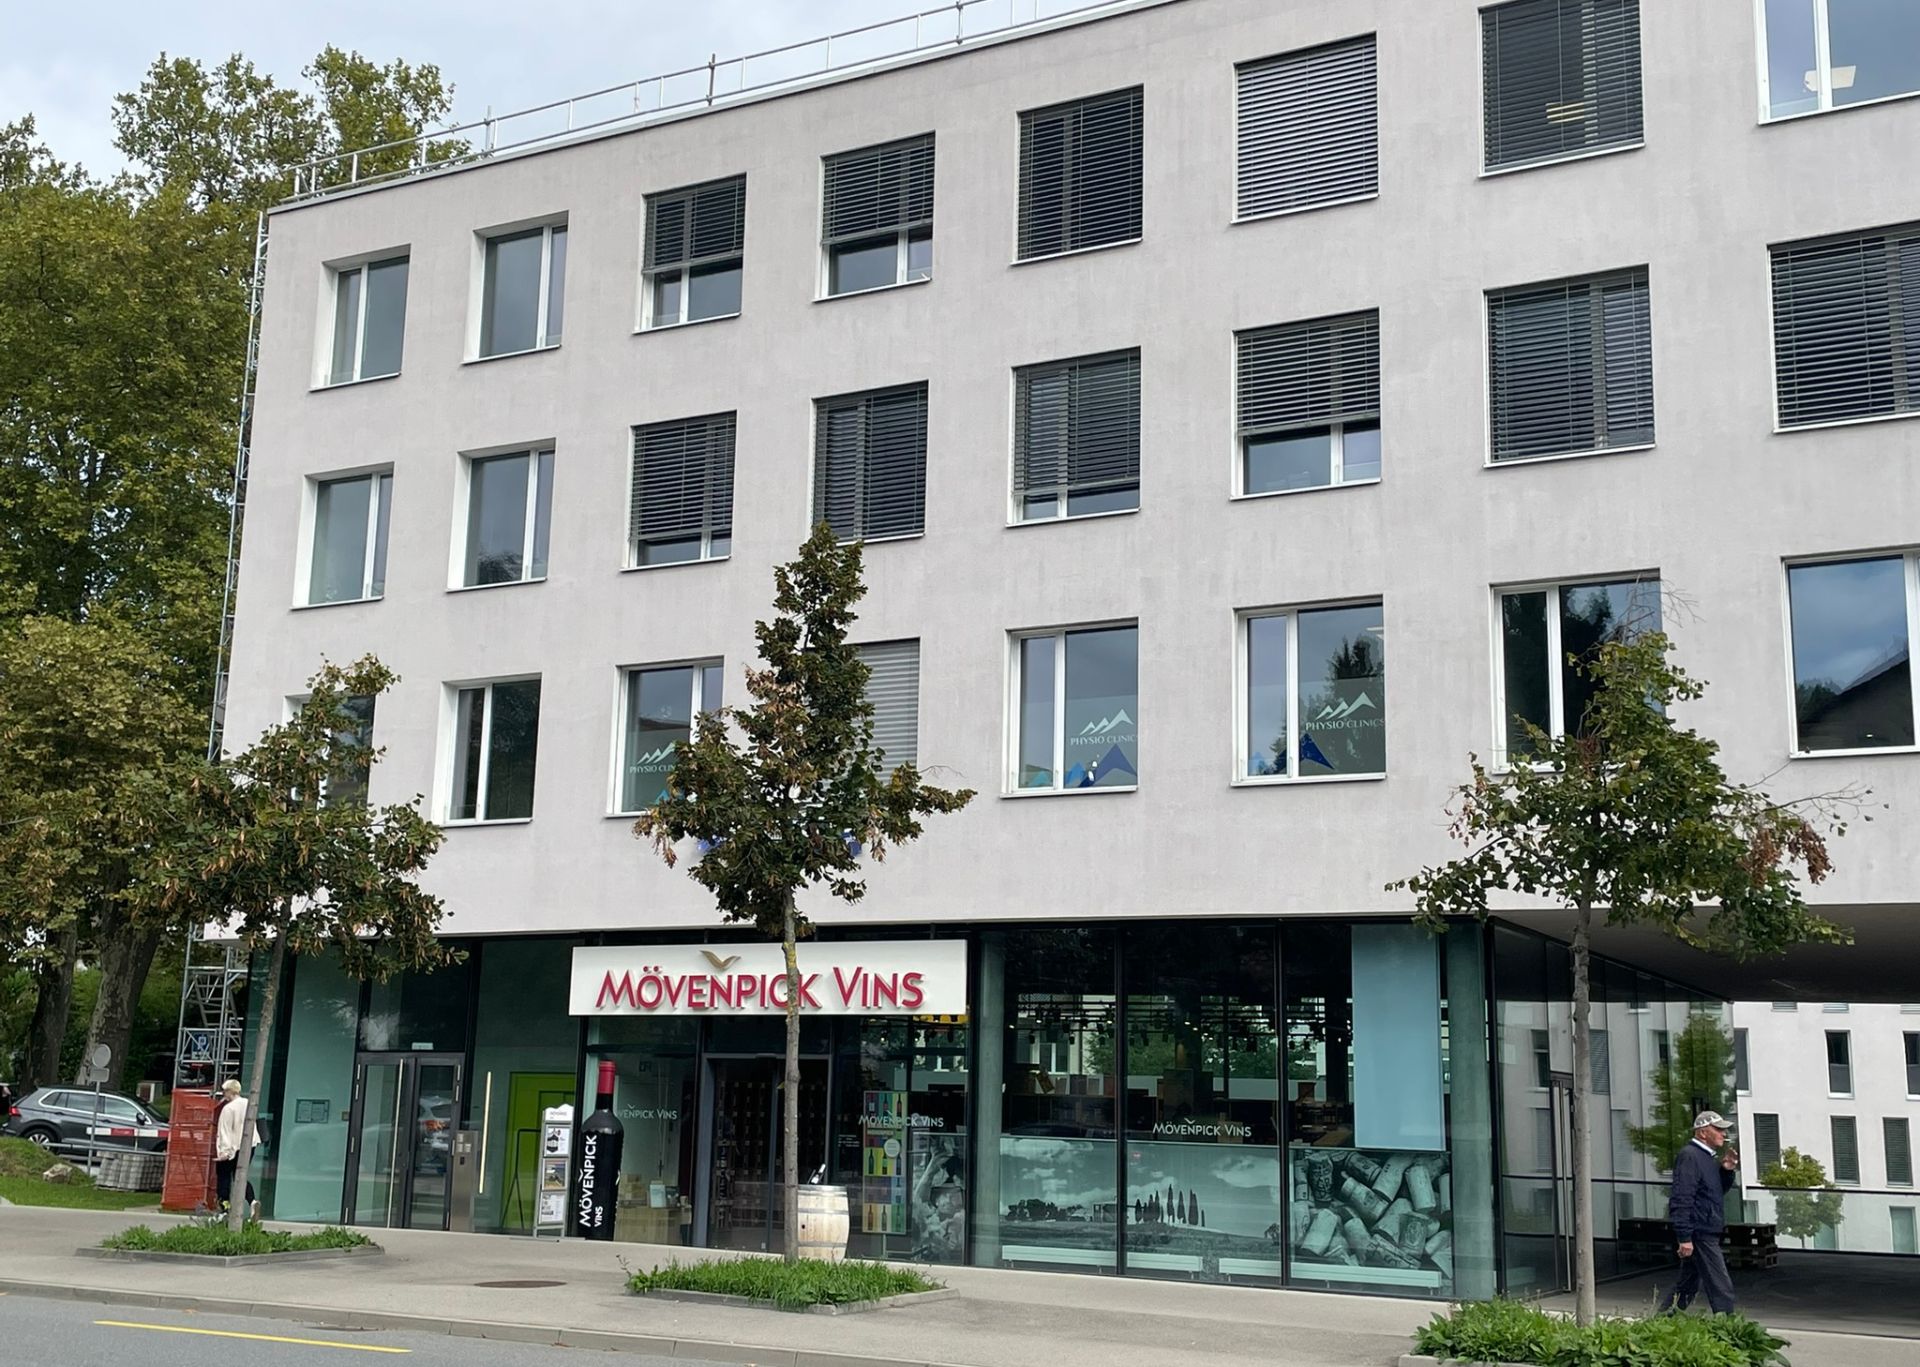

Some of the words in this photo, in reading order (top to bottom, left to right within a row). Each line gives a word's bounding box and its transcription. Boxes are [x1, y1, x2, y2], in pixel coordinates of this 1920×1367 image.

[1305, 720, 1345, 731] PHYSIO
[1070, 736, 1105, 746] PHYSIO
[1106, 735, 1137, 744] CLINIC
[629, 765, 657, 774] PHYSIO
[595, 965, 822, 1009] MÖVENPICK
[1152, 1121, 1222, 1137] MÖVENPICK
[579, 1134, 598, 1228] MÖVENPICK
[594, 1206, 605, 1228] VINS
